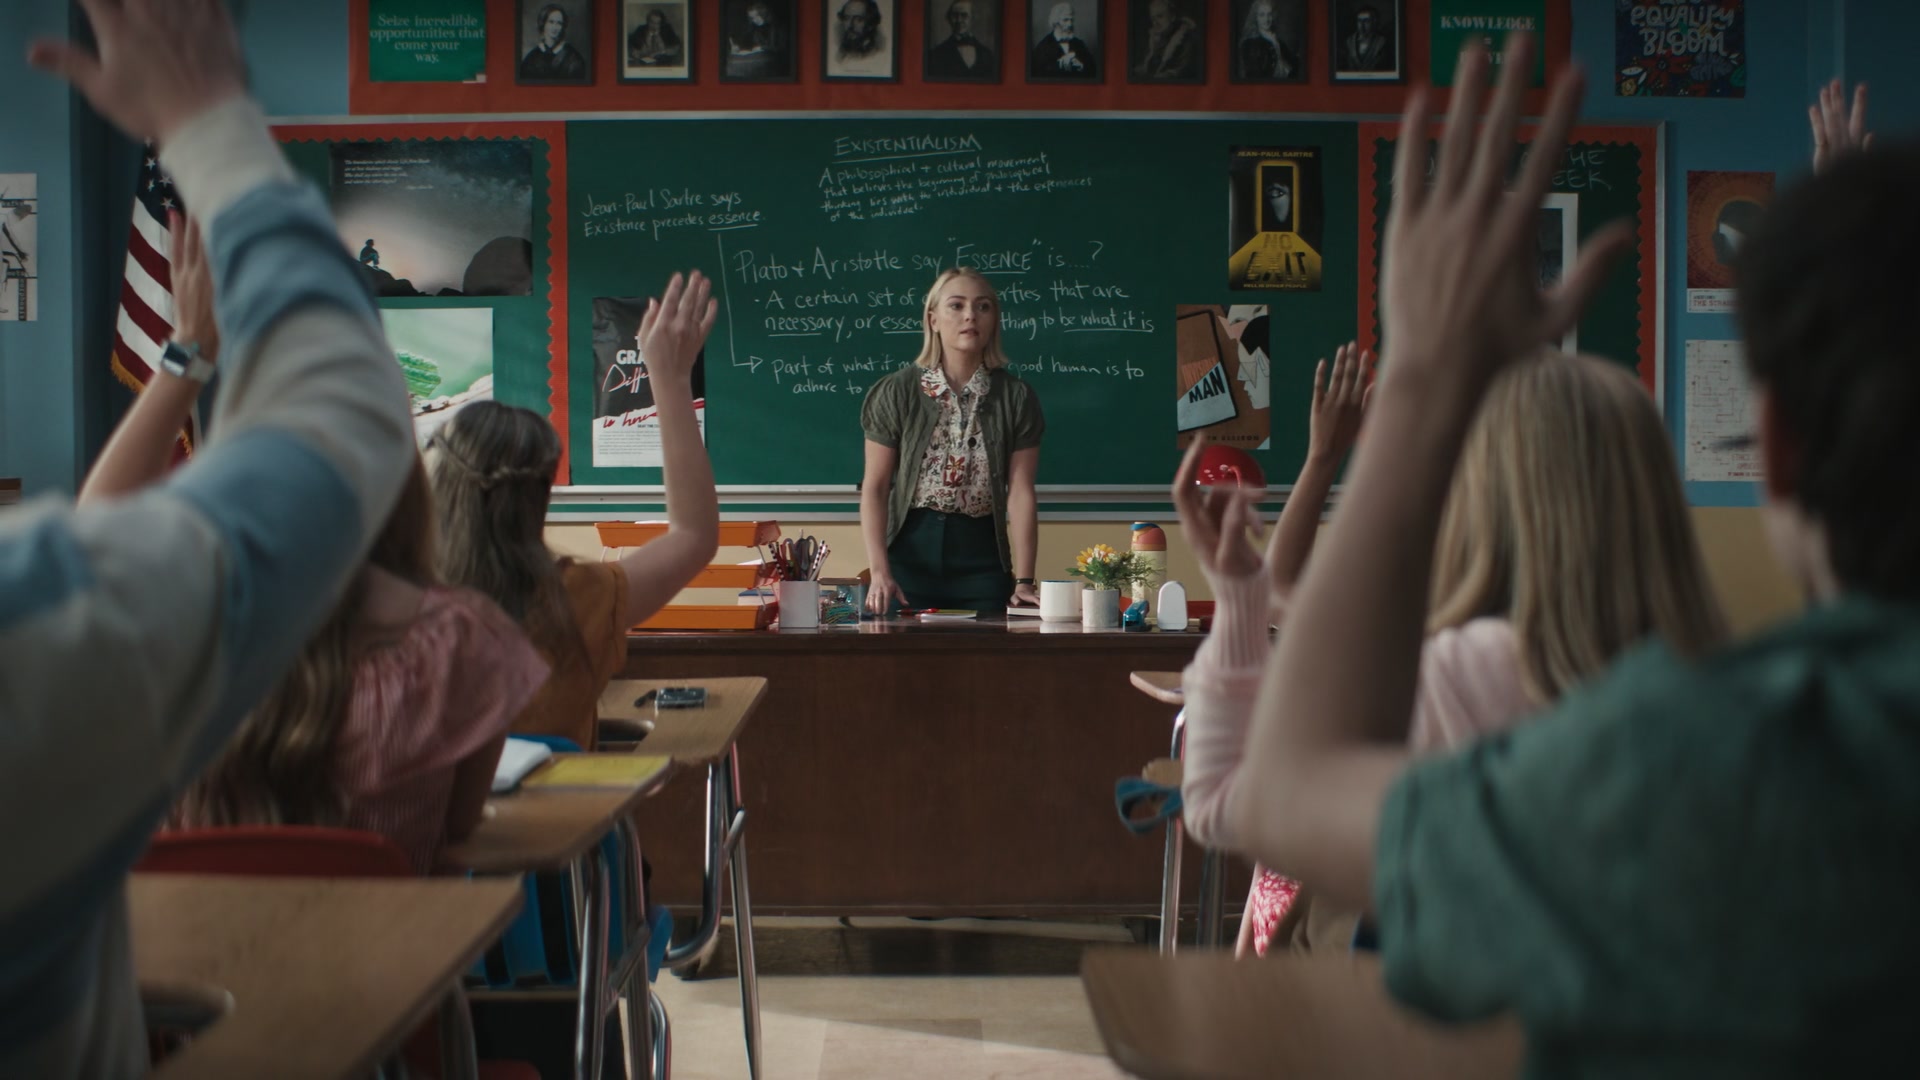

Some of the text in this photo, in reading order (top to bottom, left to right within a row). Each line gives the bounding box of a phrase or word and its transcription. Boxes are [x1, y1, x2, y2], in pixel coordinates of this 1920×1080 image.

[378, 14, 478, 26] Seize incredible
[1440, 16, 1535, 30] KNOWLEDGE
[369, 26, 486, 42] opportunities that
[394, 41, 460, 53] come your
[1639, 27, 1728, 56] BLOOM
[833, 134, 982, 157] EXISTENTIALISM
[1282, 150, 1314, 159] SARTRE
[1562, 147, 1607, 168] HE
[818, 167, 834, 188] A
[837, 162, 916, 187] philosophical
[937, 156, 981, 173] cultural
[987, 152, 1047, 169] movement
[1552, 168, 1613, 192] EEK
[820, 199, 861, 212] thinking
[937, 180, 991, 198] individual
[1008, 182, 1031, 193] the
[823, 186, 848, 199] that
[852, 182, 892, 195] believes
[894, 179, 913, 191] the
[918, 176, 965, 197] beginning
[968, 170, 982, 184] of
[582, 188, 742, 217] Jean-Paul Sartre says
[584, 218, 646, 237] Existence
[652, 214, 705, 242] precedes
[830, 210, 841, 222] of
[848, 211, 865, 220] the
[1263, 233, 1294, 250] NO
[733, 250, 789, 284] Plato
[812, 247, 904, 280] Aristotle
[911, 254, 943, 278] say
[1244, 251, 1308, 281] EXIT
[764, 290, 785, 310] A
[794, 286, 860, 309] certain
[867, 287, 894, 307] set
[899, 287, 917, 306] of
[996, 281, 1041, 304] erties
[1049, 279, 1090, 302] that
[1092, 286, 1130, 298] are
[855, 315, 876, 329] or
[880, 315, 924, 330] essen
[1039, 309, 1055, 329] to
[1059, 306, 1077, 326] be
[1081, 307, 1118, 328] what
[1123, 310, 1136, 329] it
[1141, 311, 1155, 331] is
[602, 363, 650, 394] Diffe
[771, 355, 813, 385] part
[817, 357, 835, 375] of
[842, 356, 875, 372] what
[880, 353, 895, 371] it
[1007, 355, 1043, 379] good
[1051, 356, 1101, 375] human
[1106, 359, 1120, 376] is
[1125, 360, 1144, 380] to
[792, 378, 863, 394] adhere to
[1189, 366, 1226, 404] MAN
